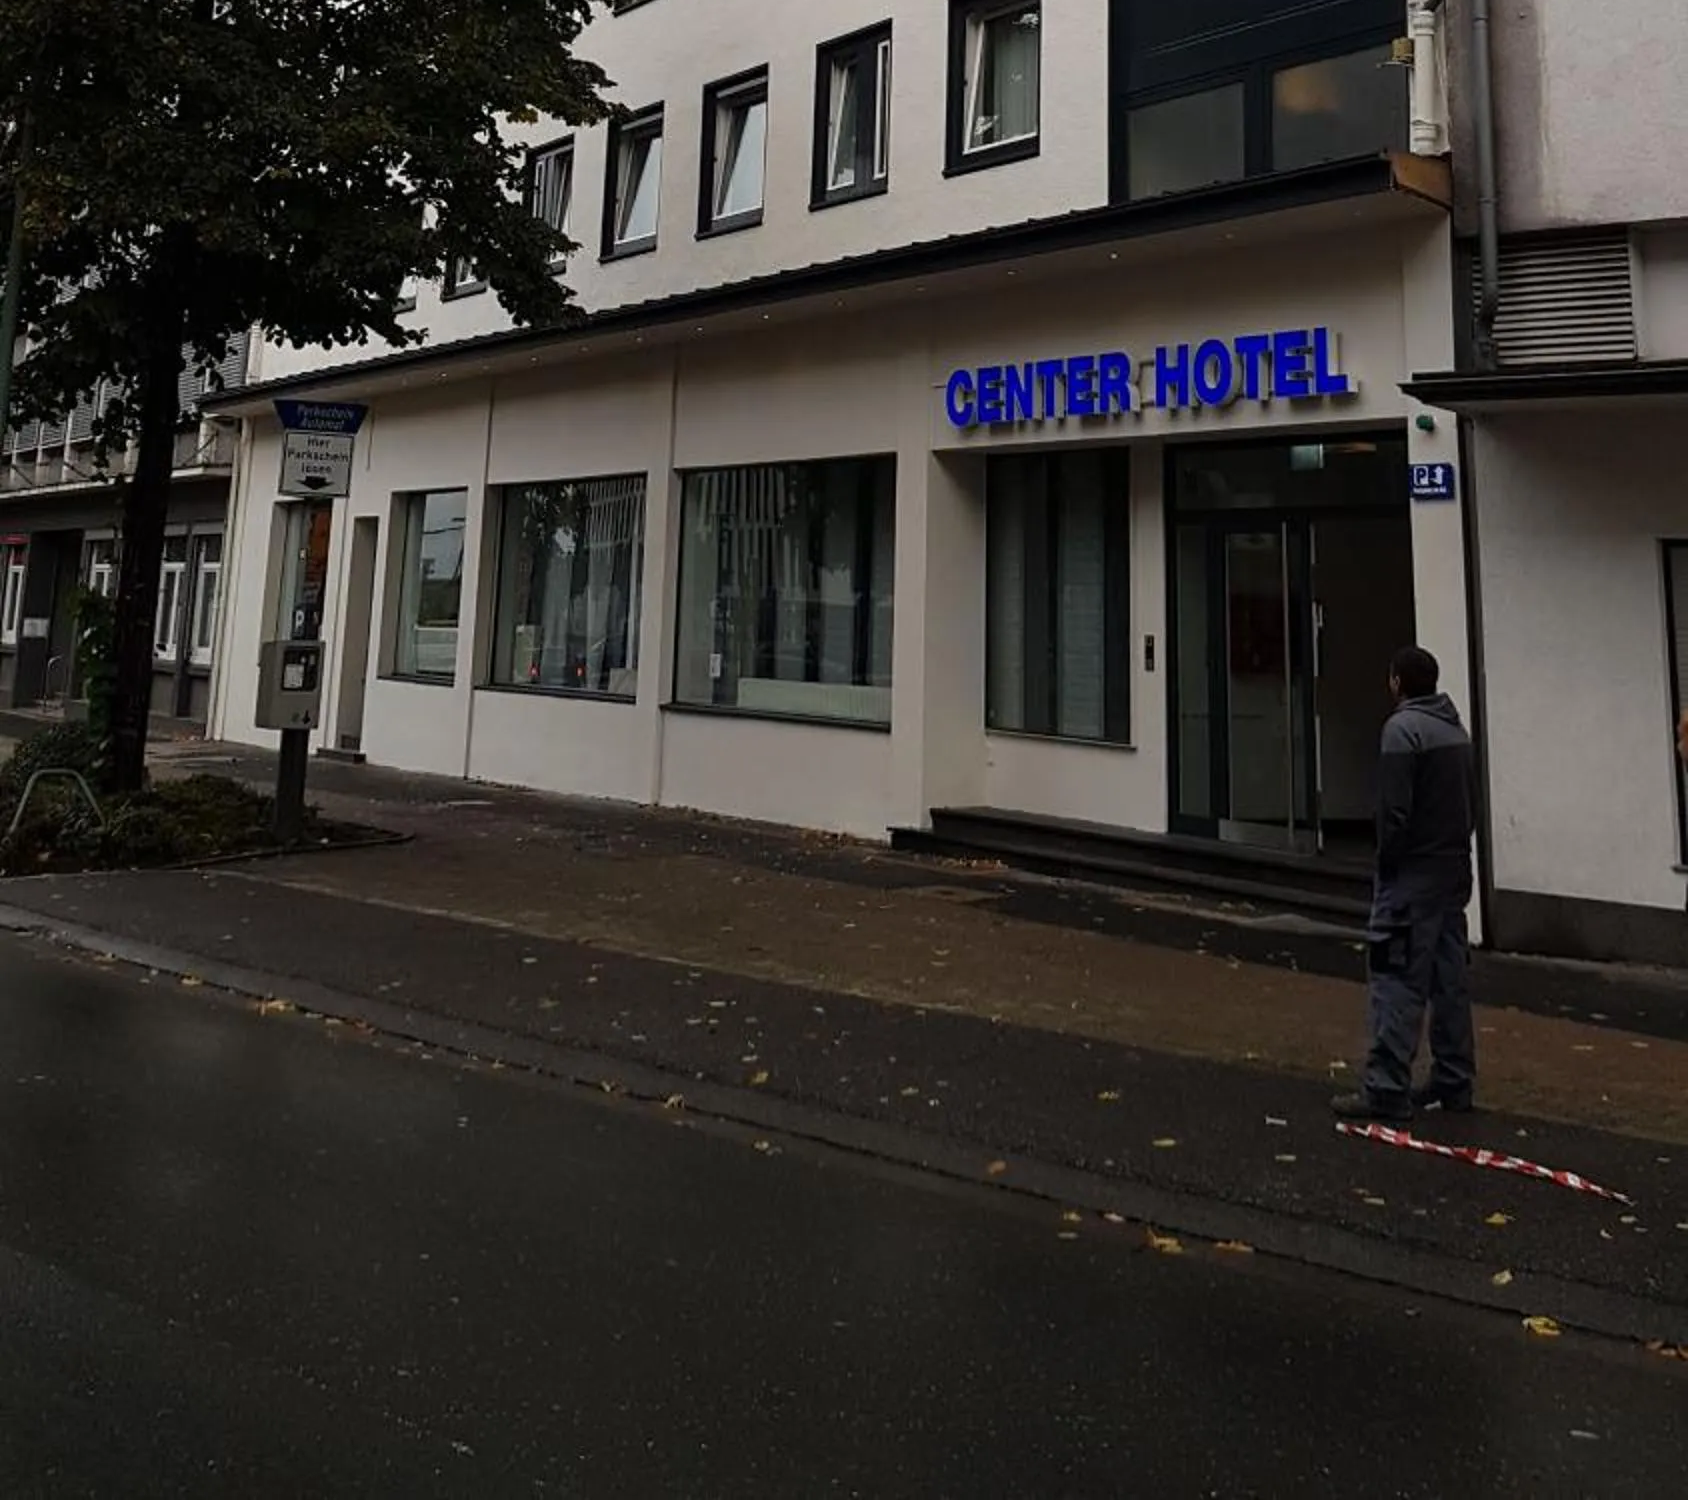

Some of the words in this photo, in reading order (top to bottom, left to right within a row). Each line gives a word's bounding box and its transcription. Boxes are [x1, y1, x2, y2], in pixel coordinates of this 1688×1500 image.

[946, 351, 1131, 427] CENTER
[1155, 327, 1348, 405] HOTEL
[307, 437, 331, 448] Hier
[287, 449, 349, 463] Parkschein
